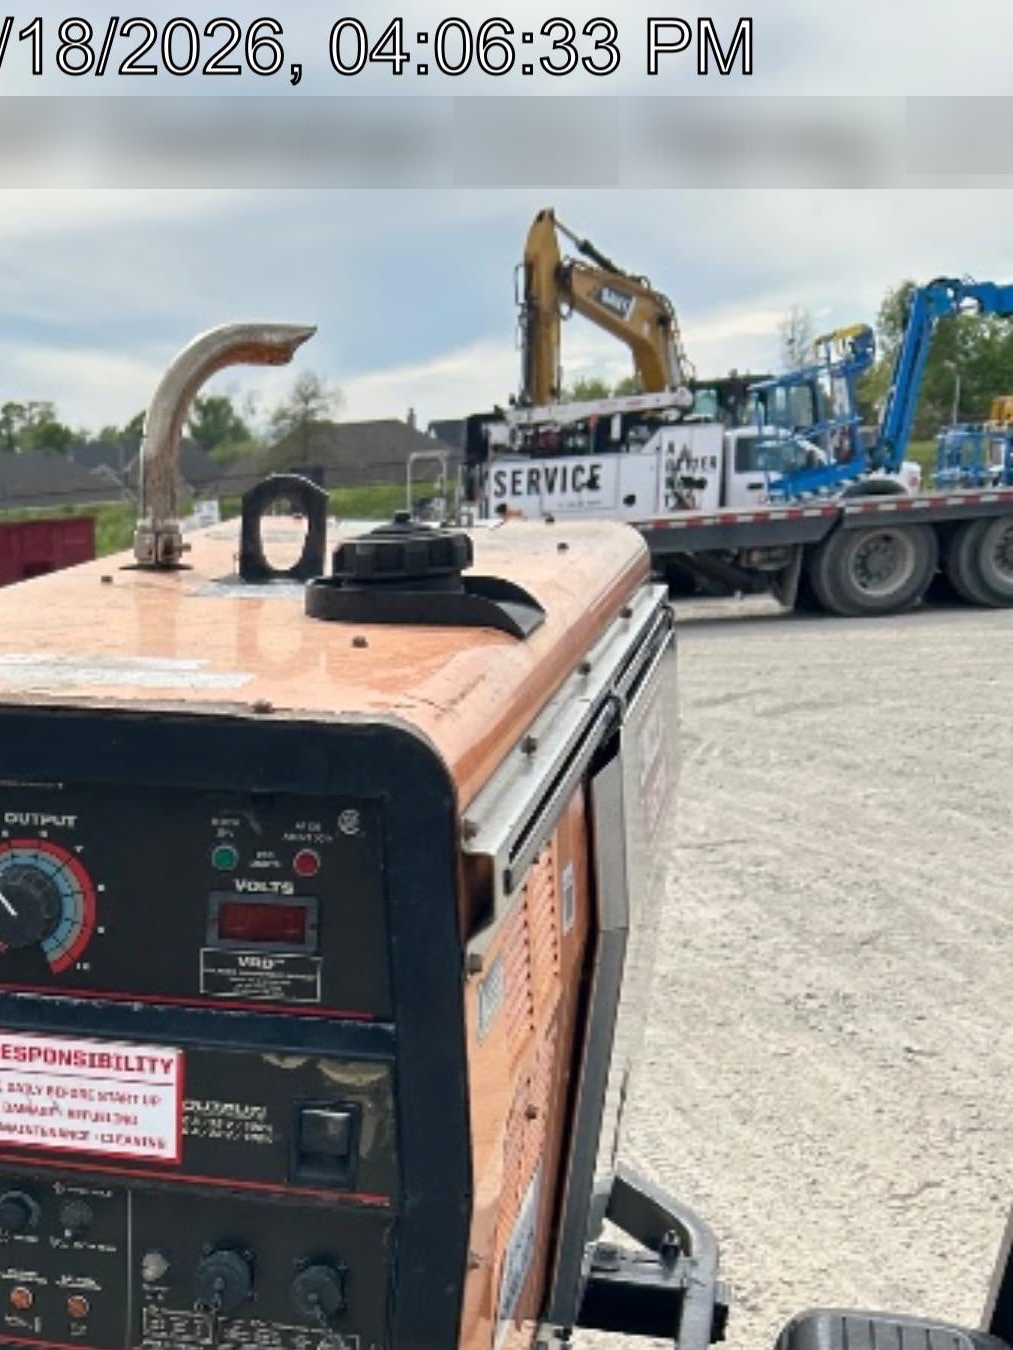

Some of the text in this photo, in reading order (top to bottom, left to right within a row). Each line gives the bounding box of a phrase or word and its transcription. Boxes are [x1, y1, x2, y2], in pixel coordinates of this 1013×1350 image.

[493, 463, 602, 498] SERVICE
[4, 811, 78, 828] OUTPUT
[234, 878, 295, 895] VOLTS
